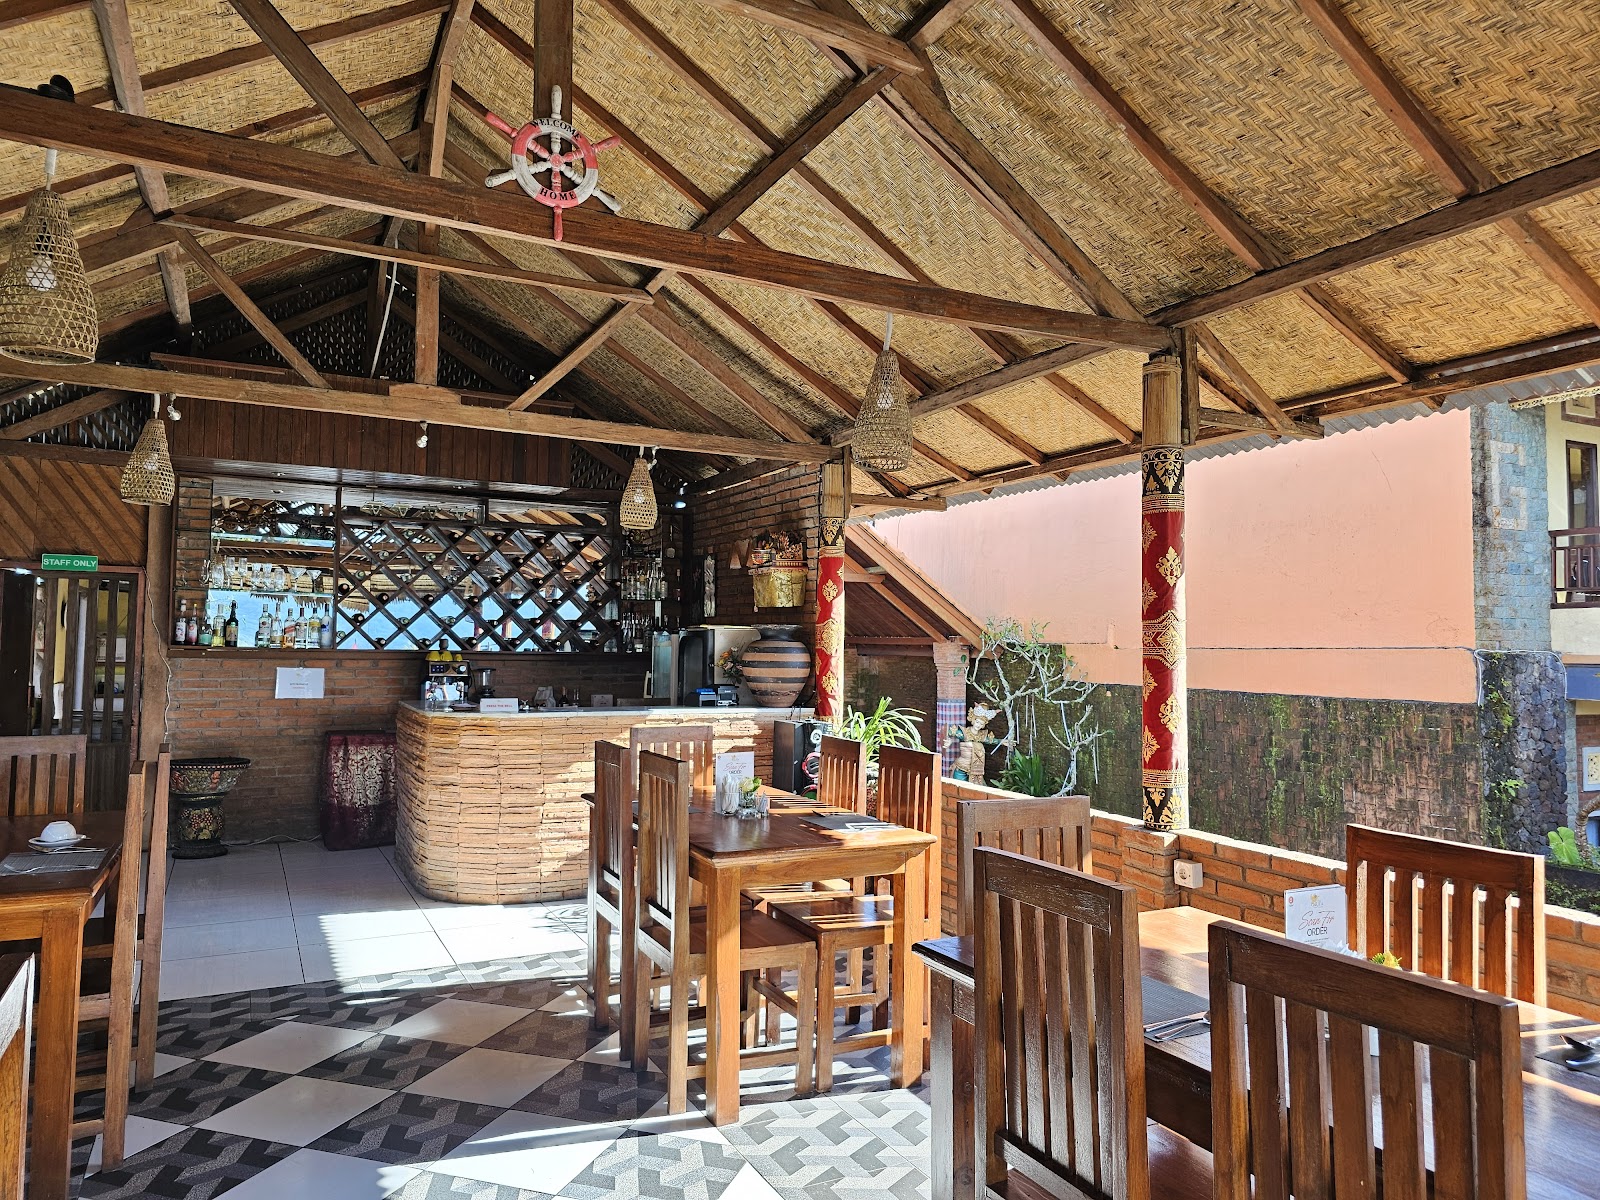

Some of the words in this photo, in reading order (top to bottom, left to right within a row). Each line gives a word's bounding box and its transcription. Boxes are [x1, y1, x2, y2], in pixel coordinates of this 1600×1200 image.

[530, 119, 581, 140] WELCOME
[540, 188, 576, 200] HOME
[1306, 926, 1328, 937] ORDER
